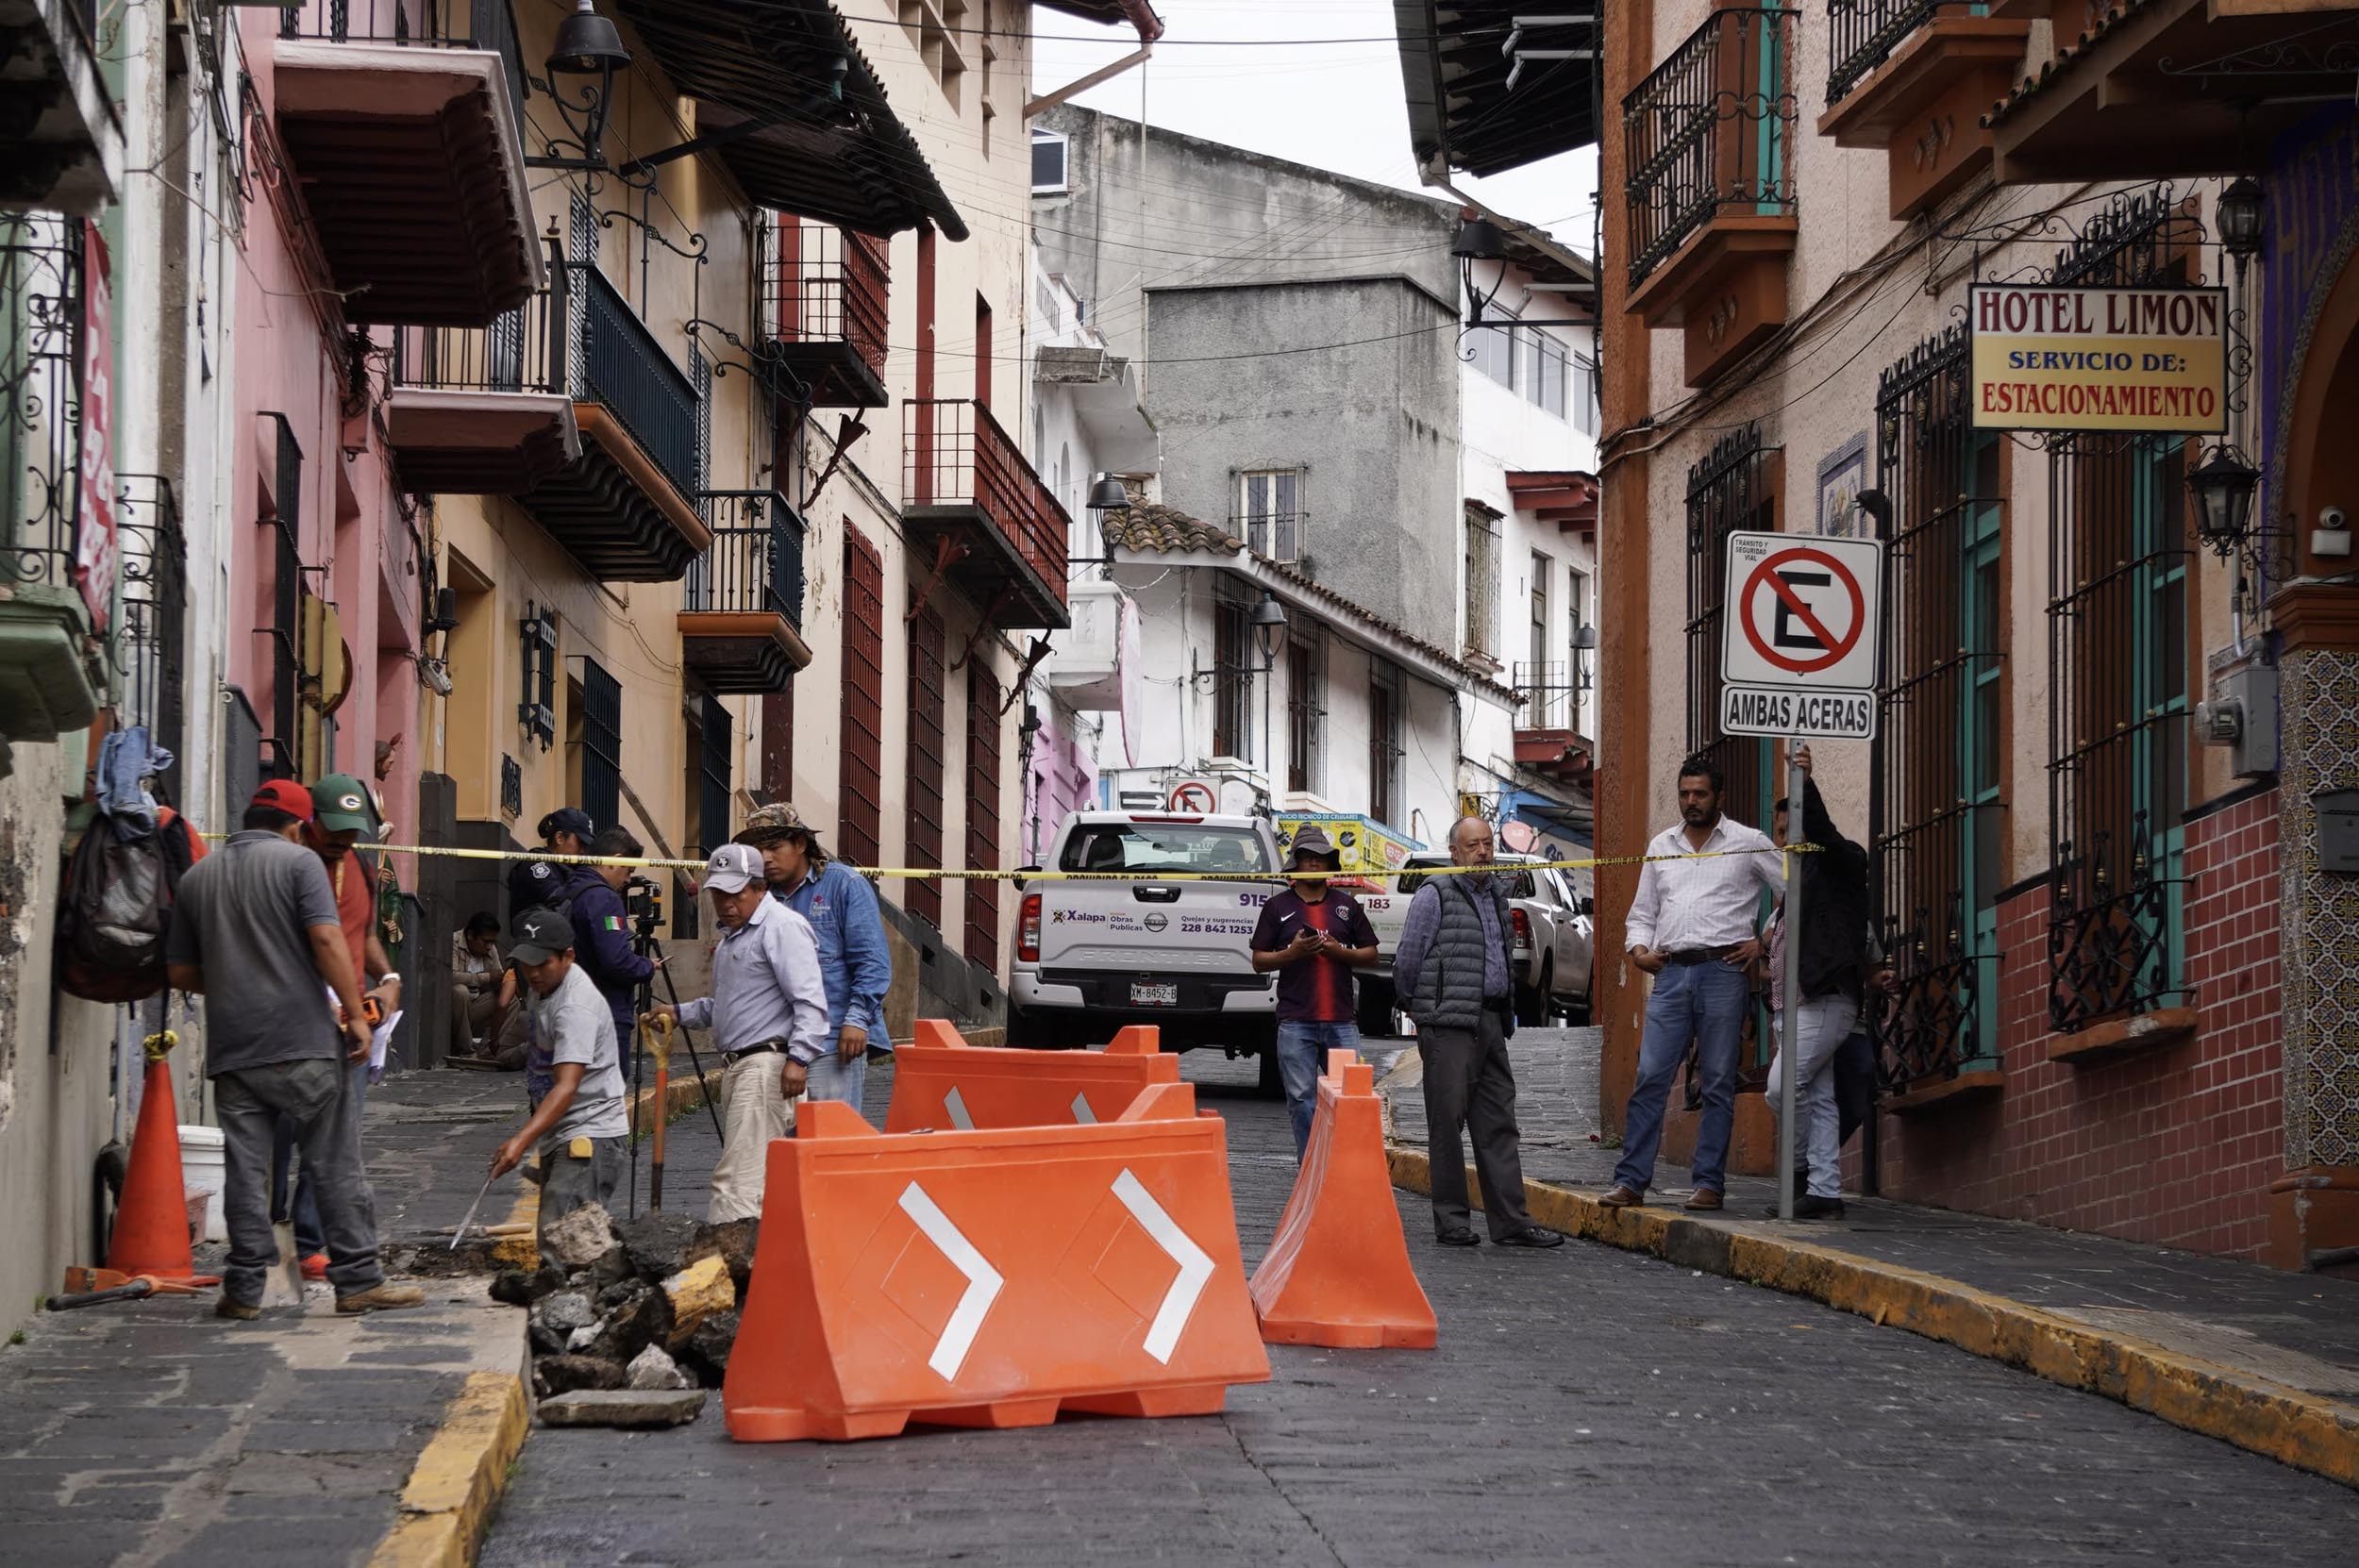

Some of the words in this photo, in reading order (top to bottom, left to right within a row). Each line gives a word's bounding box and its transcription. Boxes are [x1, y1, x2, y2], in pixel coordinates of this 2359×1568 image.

[1979, 292, 2094, 333] HOTEL
[2106, 293, 2217, 336] LIMON
[2009, 351, 2133, 371] SERVICIO
[2142, 354, 2186, 372] DE:
[1982, 382, 2215, 418] ESTACIONAMIENTO
[1735, 546, 1766, 555] SEGURIDAD
[1773, 571, 1831, 650] E
[1729, 693, 1791, 728] AMBAS
[1796, 697, 1867, 732] ACERAS
[339, 793, 362, 812] G
[1239, 892, 1268, 908] 915
[1367, 898, 1390, 909] 183
[1067, 909, 1106, 923] Xalapa
[1181, 924, 1201, 932] 228
[1205, 925, 1226, 933] 842
[1229, 926, 1253, 934] 1253
